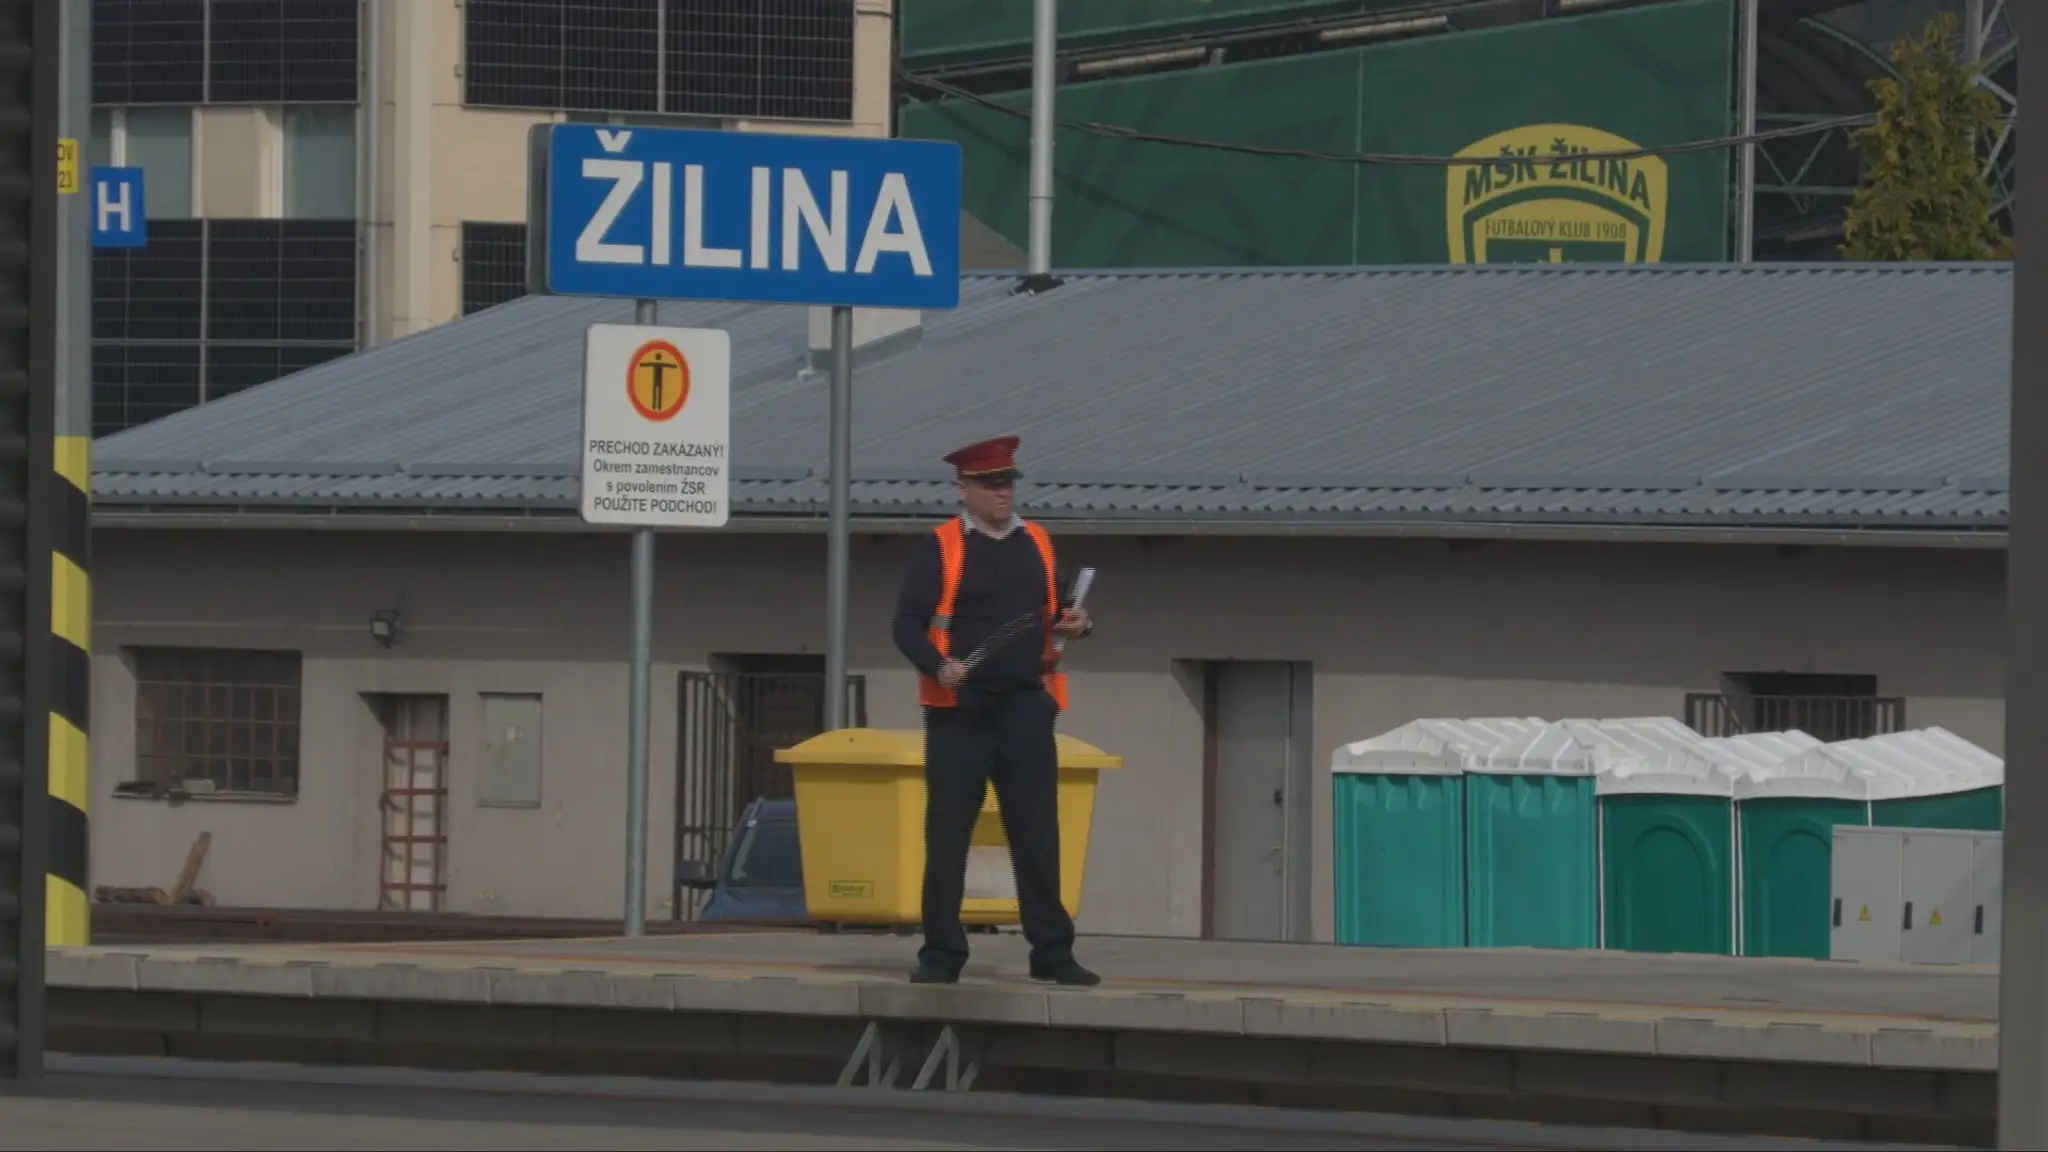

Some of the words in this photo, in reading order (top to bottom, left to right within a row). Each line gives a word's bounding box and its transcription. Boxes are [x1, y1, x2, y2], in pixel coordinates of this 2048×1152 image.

[1463, 143, 1538, 206] MŠK
[1549, 137, 1651, 210] ŽILINA
[97, 181, 131, 232] H
[575, 129, 934, 277] ŽILINA
[1485, 217, 1556, 237] FUTBALOVÝ
[1559, 221, 1591, 238] KLUB
[1596, 223, 1627, 239] 1908
[589, 440, 650, 455] PRECHOD
[652, 440, 724, 458] ZAKÁZANÝ!
[593, 459, 632, 473] Okrem
[635, 462, 719, 477] zamestnancov
[606, 481, 613, 492] s
[616, 479, 679, 494] povolením
[681, 477, 706, 495] ŽSR
[594, 494, 647, 512] POUŽITE
